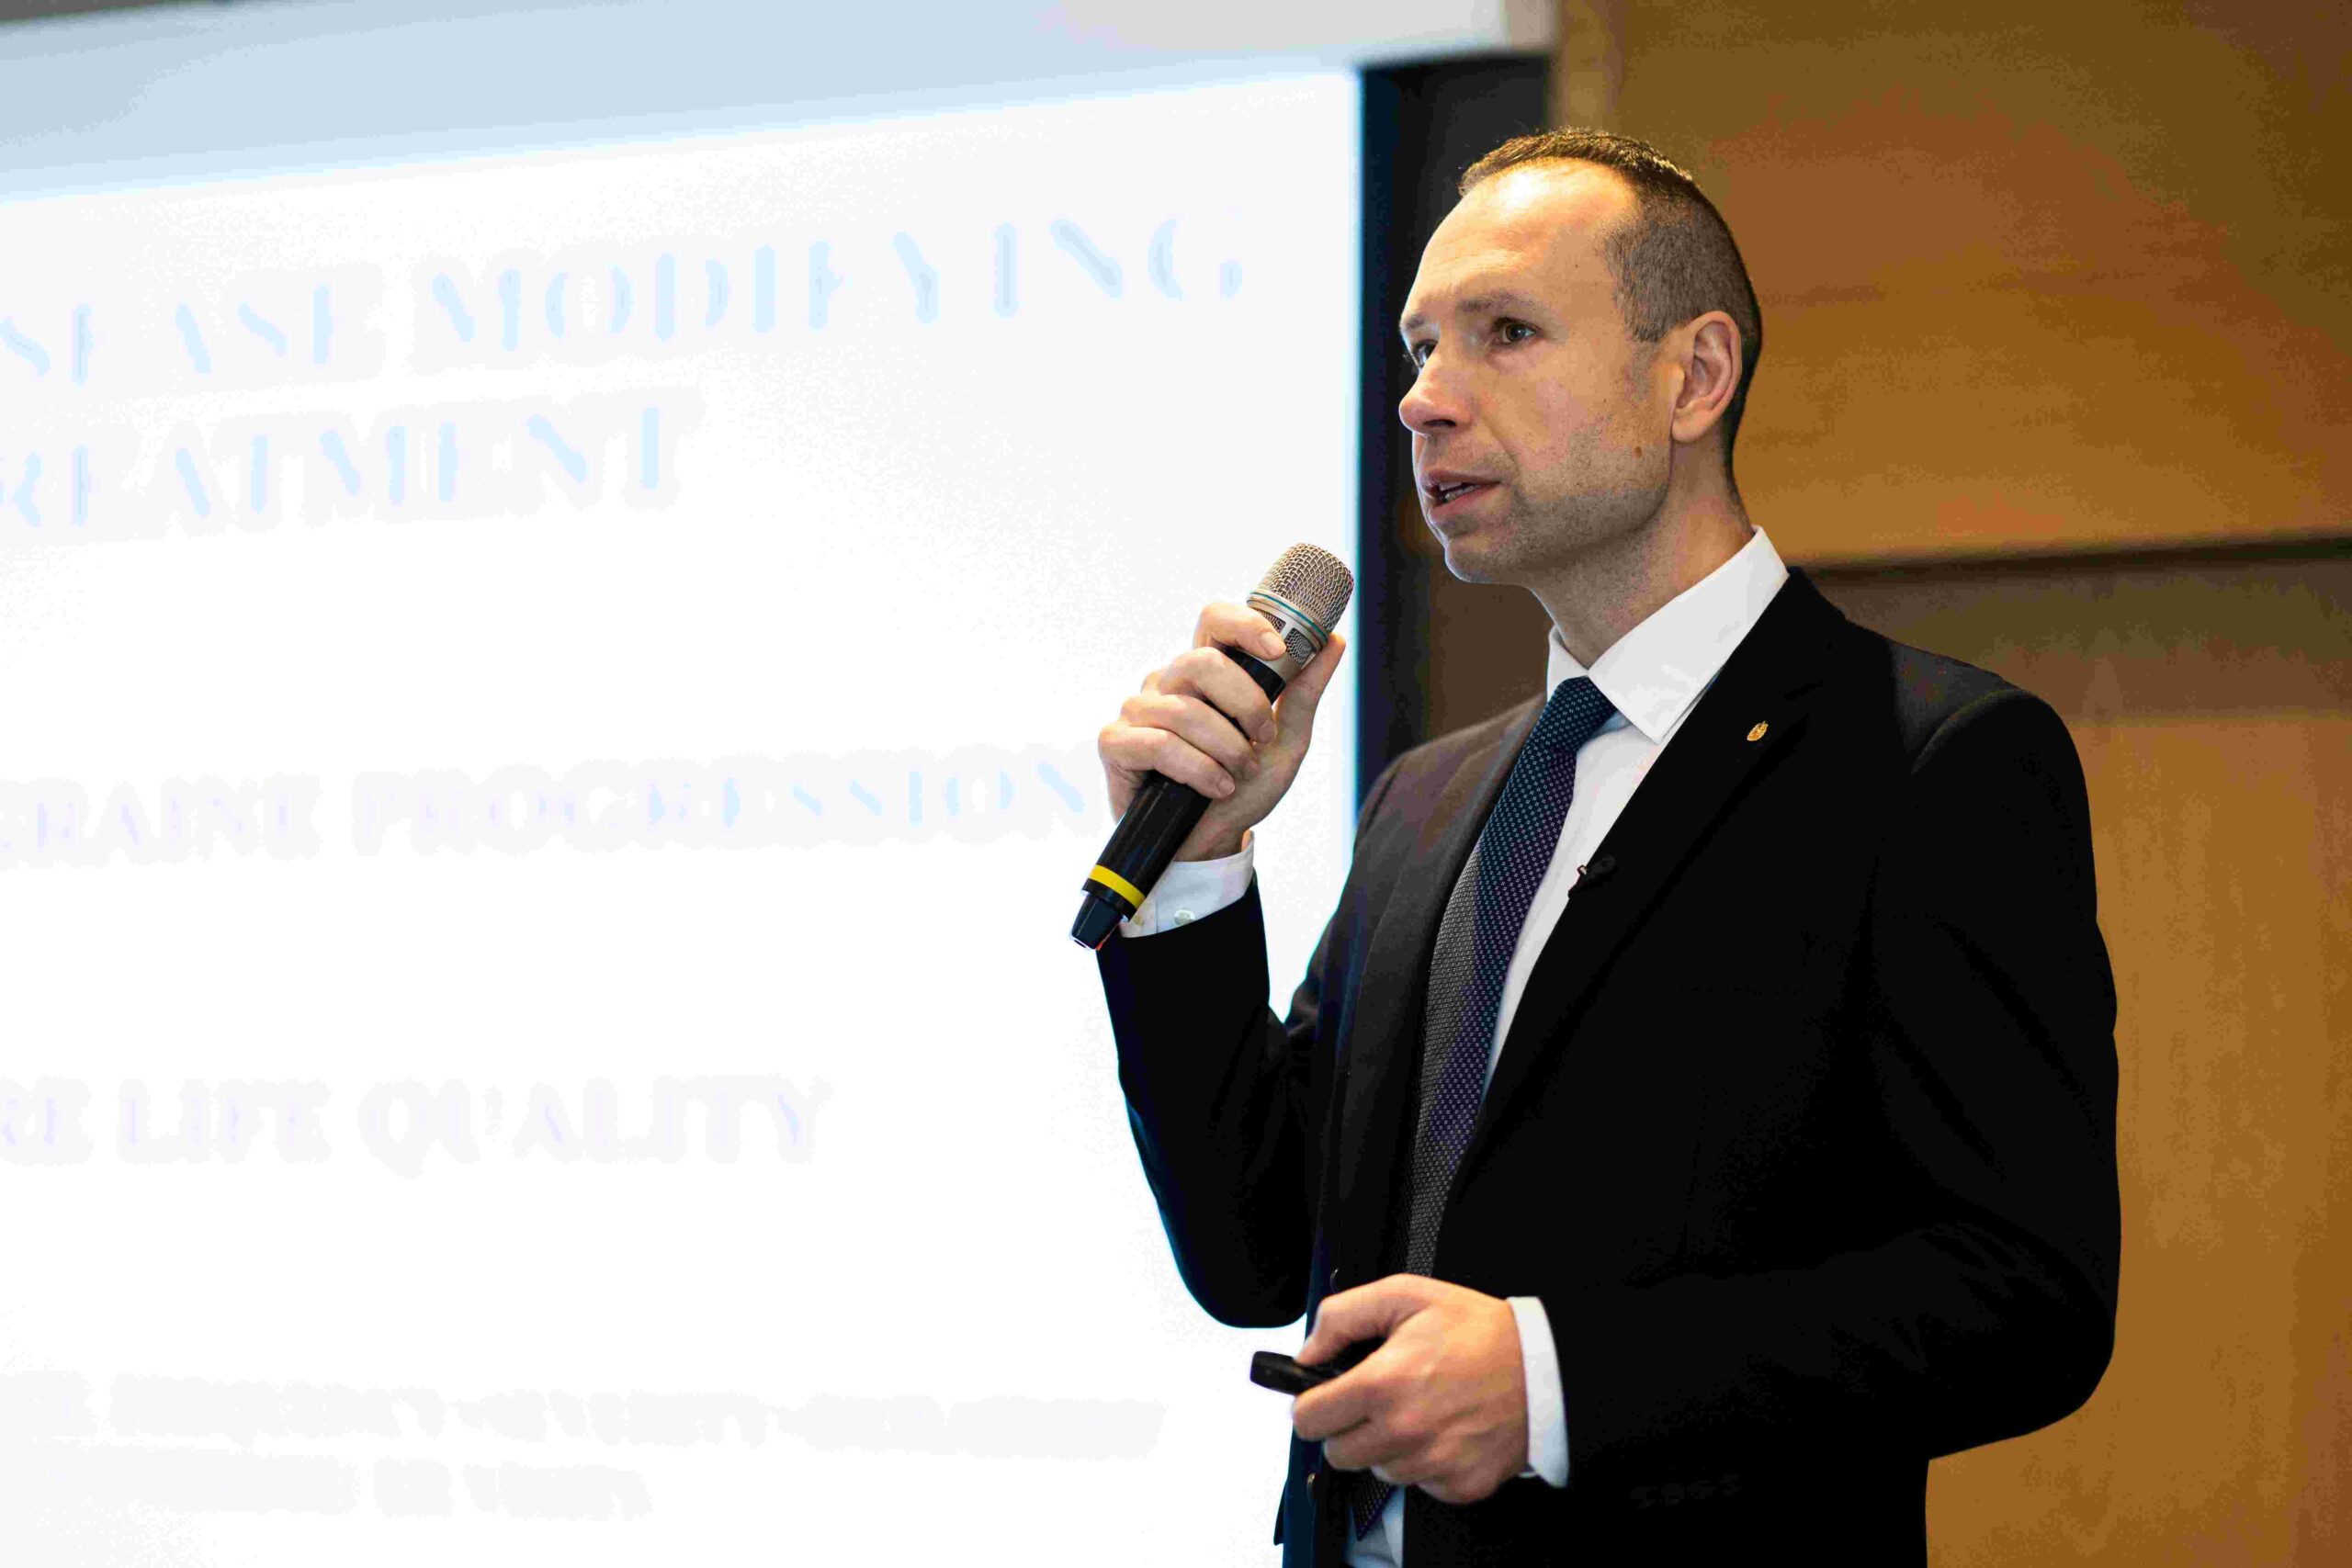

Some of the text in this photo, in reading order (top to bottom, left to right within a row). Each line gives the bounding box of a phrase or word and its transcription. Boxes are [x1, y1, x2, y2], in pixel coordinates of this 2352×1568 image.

[413, 211, 1248, 362] MODIFYING
[354, 746, 1099, 854] PROGRESSION
[118, 1078, 329, 1164] LIFE
[360, 1077, 831, 1177] QUALITY
